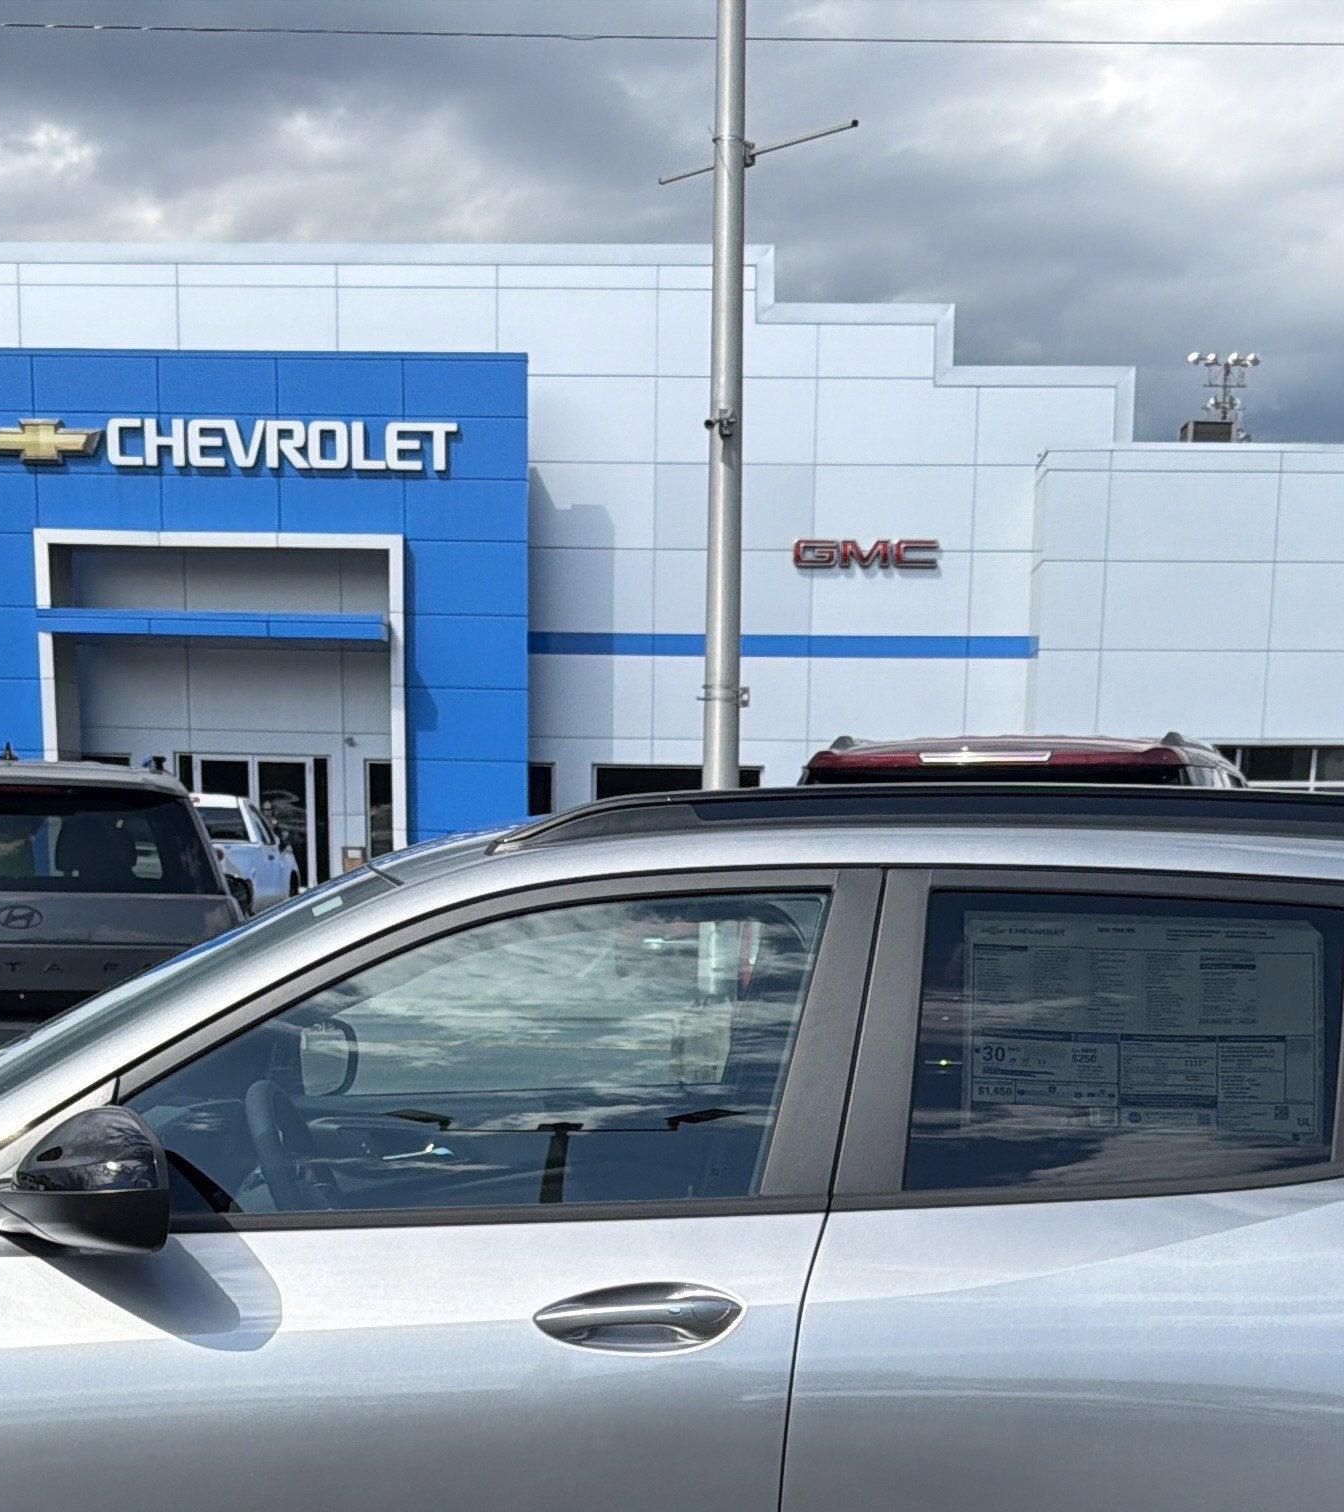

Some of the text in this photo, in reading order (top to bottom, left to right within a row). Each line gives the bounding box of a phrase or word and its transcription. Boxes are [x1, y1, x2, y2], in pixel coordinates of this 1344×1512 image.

[107, 418, 458, 472] CHEVROLET
[793, 539, 940, 570] GMC
[982, 1045, 1006, 1062] 30
[1071, 1053, 1097, 1064] $250
